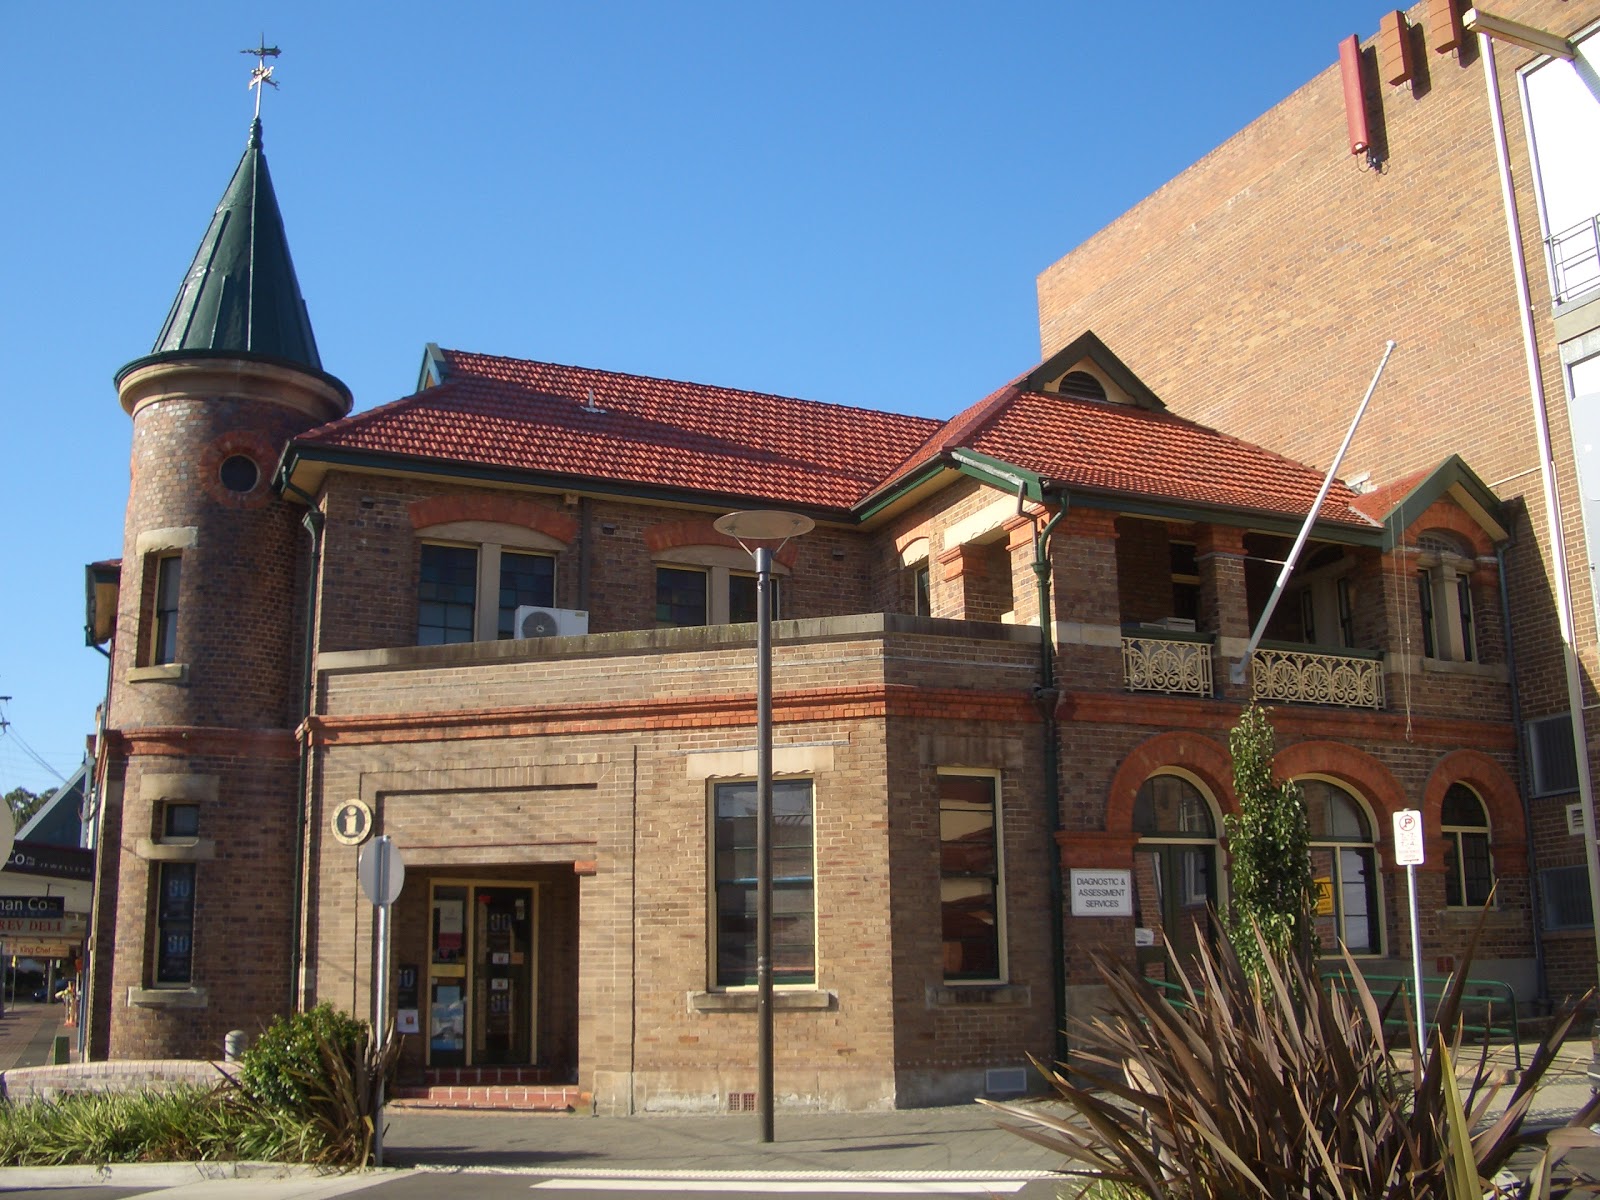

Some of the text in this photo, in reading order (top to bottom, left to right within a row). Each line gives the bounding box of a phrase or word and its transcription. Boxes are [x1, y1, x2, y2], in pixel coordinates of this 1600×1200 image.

[1076, 877, 1126, 886] DIAGNOSTIC &
[1078, 888, 1126, 897] ASSESSMENT
[28, 897, 48, 911] Co
[1085, 899, 1120, 908] SERVICES
[29, 920, 62, 932] DELI
[20, 946, 33, 955] King
[35, 946, 52, 954] Chef
